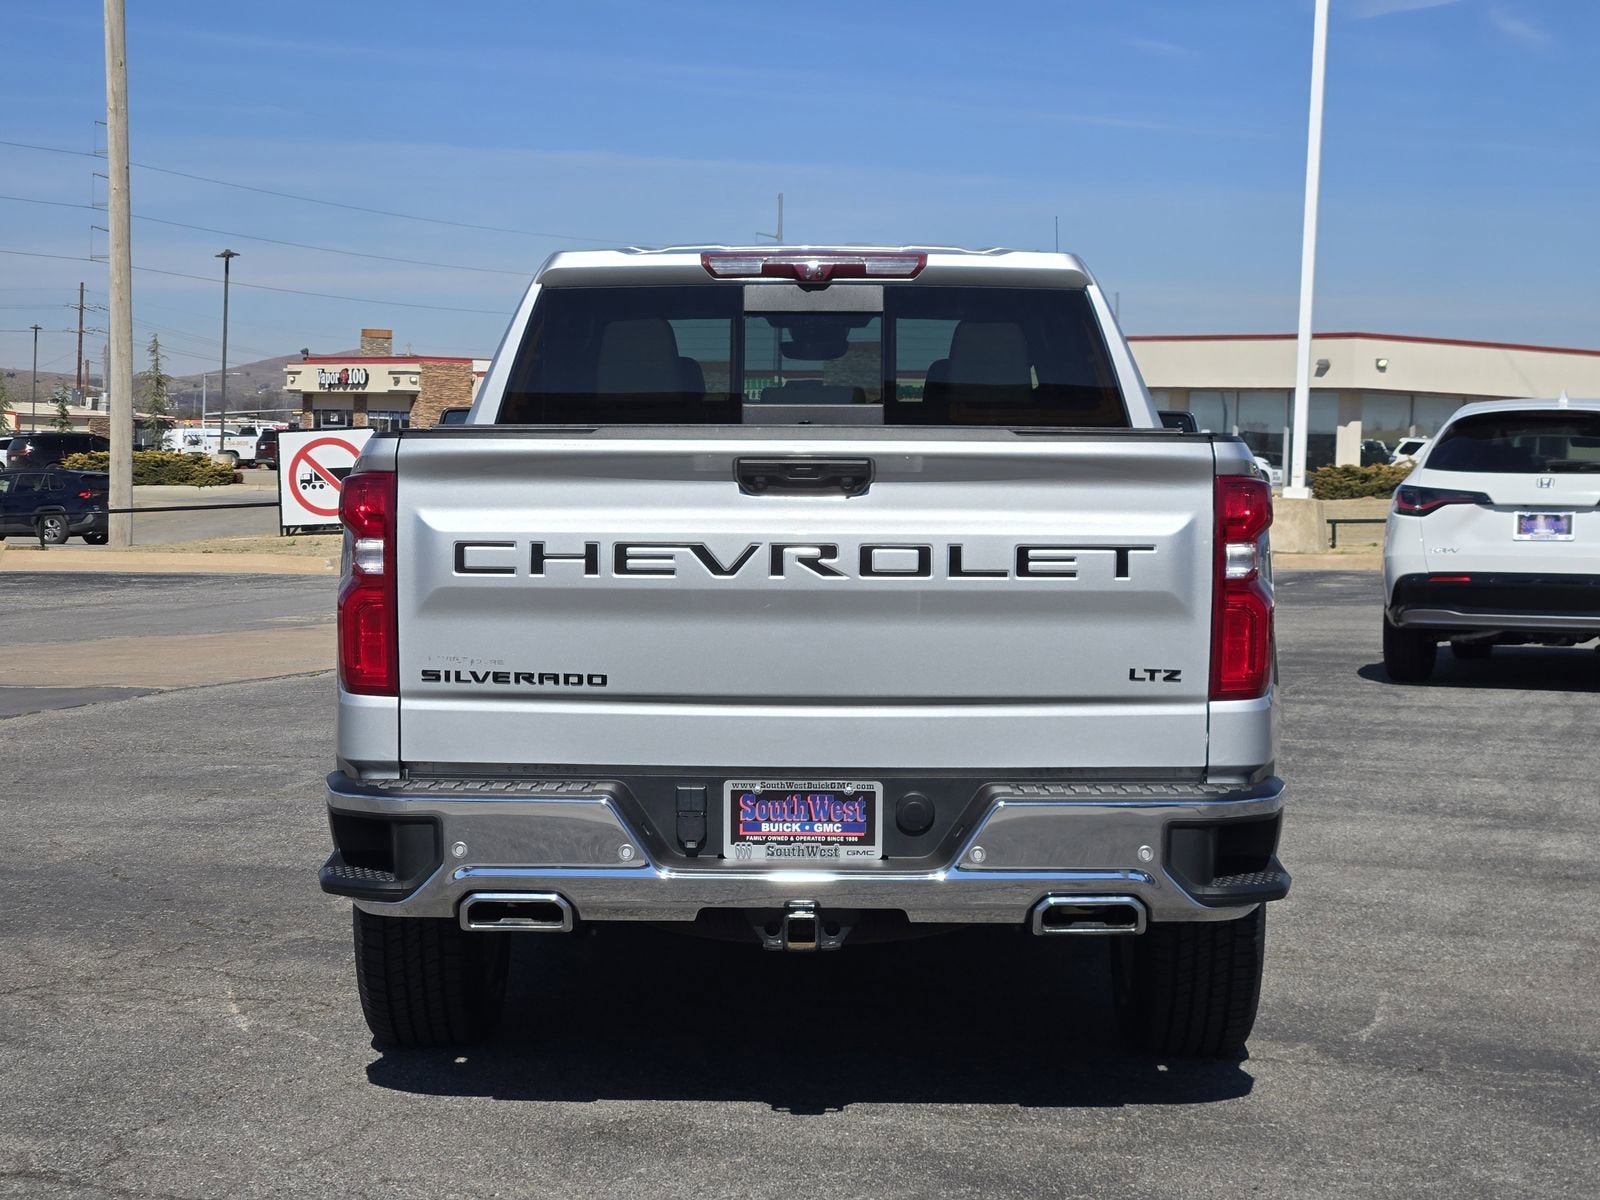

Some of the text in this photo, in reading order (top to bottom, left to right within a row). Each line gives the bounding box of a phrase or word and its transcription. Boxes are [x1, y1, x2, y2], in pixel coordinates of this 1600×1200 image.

[316, 369, 366, 388] Vapor 100
[453, 540, 1157, 581] CHEVROLET
[421, 669, 608, 687] SILVERADO
[1129, 668, 1182, 683] LTZ
[731, 781, 875, 790] wwwSouthWestBuickGMC.com
[739, 794, 867, 822] SouthWest
[761, 822, 842, 833] BUICK GMC
[766, 845, 840, 858] SouthWest
